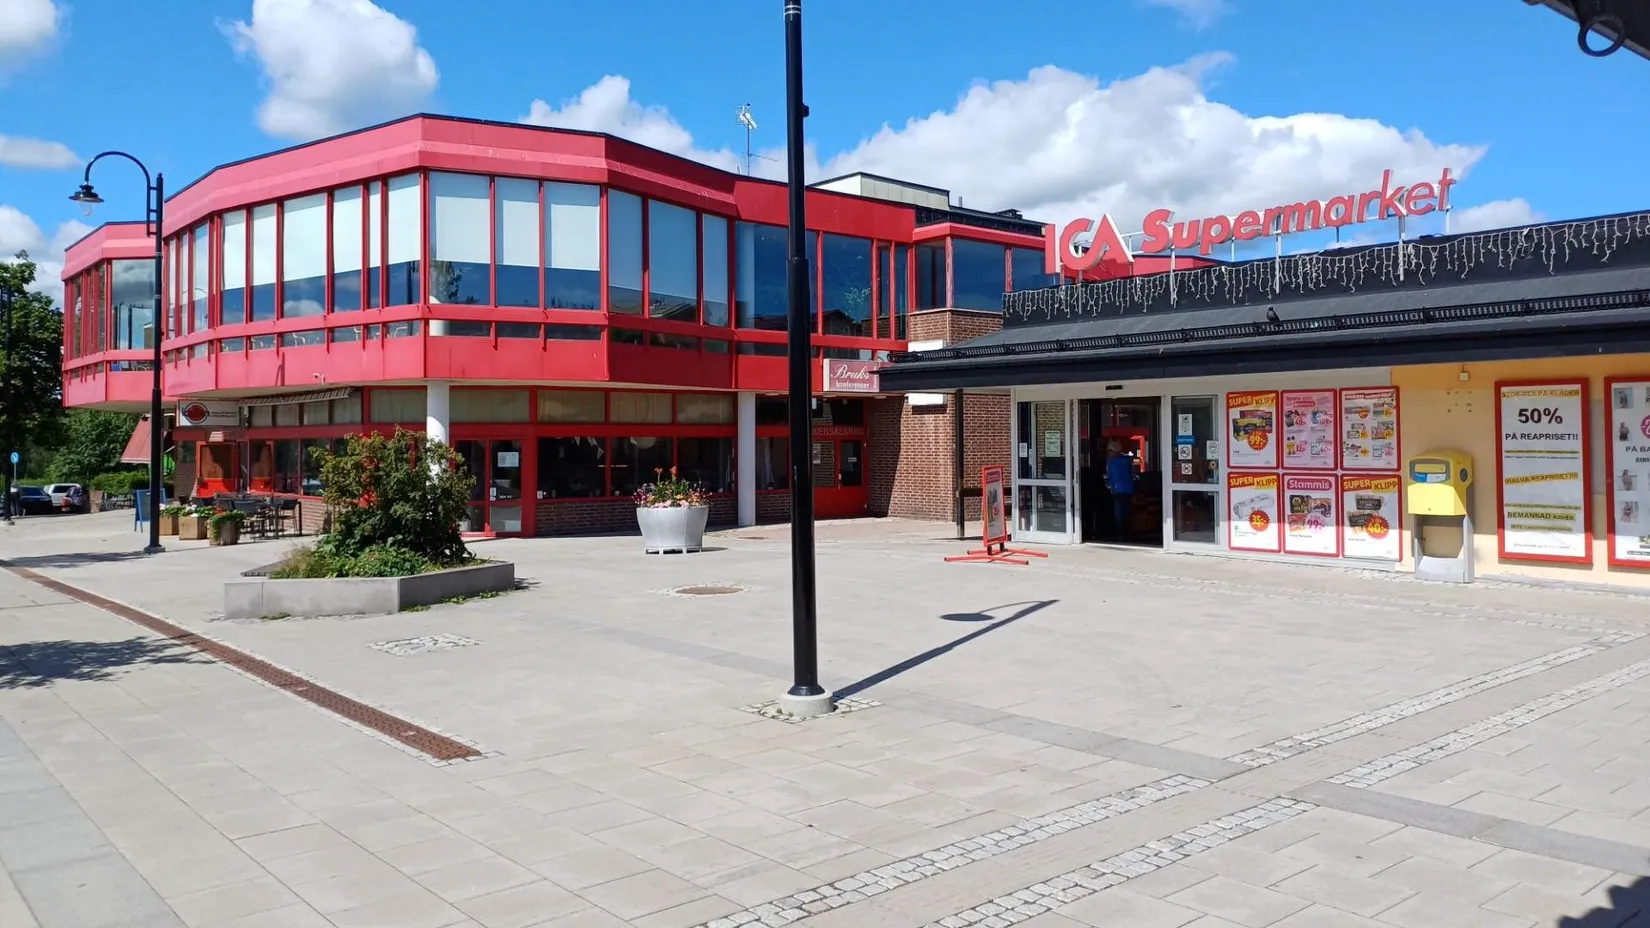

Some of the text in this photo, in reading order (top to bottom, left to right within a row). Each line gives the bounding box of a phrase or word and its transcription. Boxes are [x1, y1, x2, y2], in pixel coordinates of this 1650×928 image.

[1045, 167, 1457, 274] ICA Supermarket
[831, 364, 869, 379] Bruks
[1229, 395, 1254, 406] SUPER
[1255, 396, 1276, 406] KLIPP
[1518, 407, 1563, 424] 50%
[1505, 432, 1518, 440] PÅ
[1230, 477, 1277, 487] SUPER KLIPP
[1289, 480, 1331, 489] Stammis
[1344, 479, 1397, 490] SUPER KLIPP
[1507, 511, 1551, 519] BEMANNAD
[1307, 519, 1325, 529] 99:-
[1368, 523, 1387, 534] 40:-
